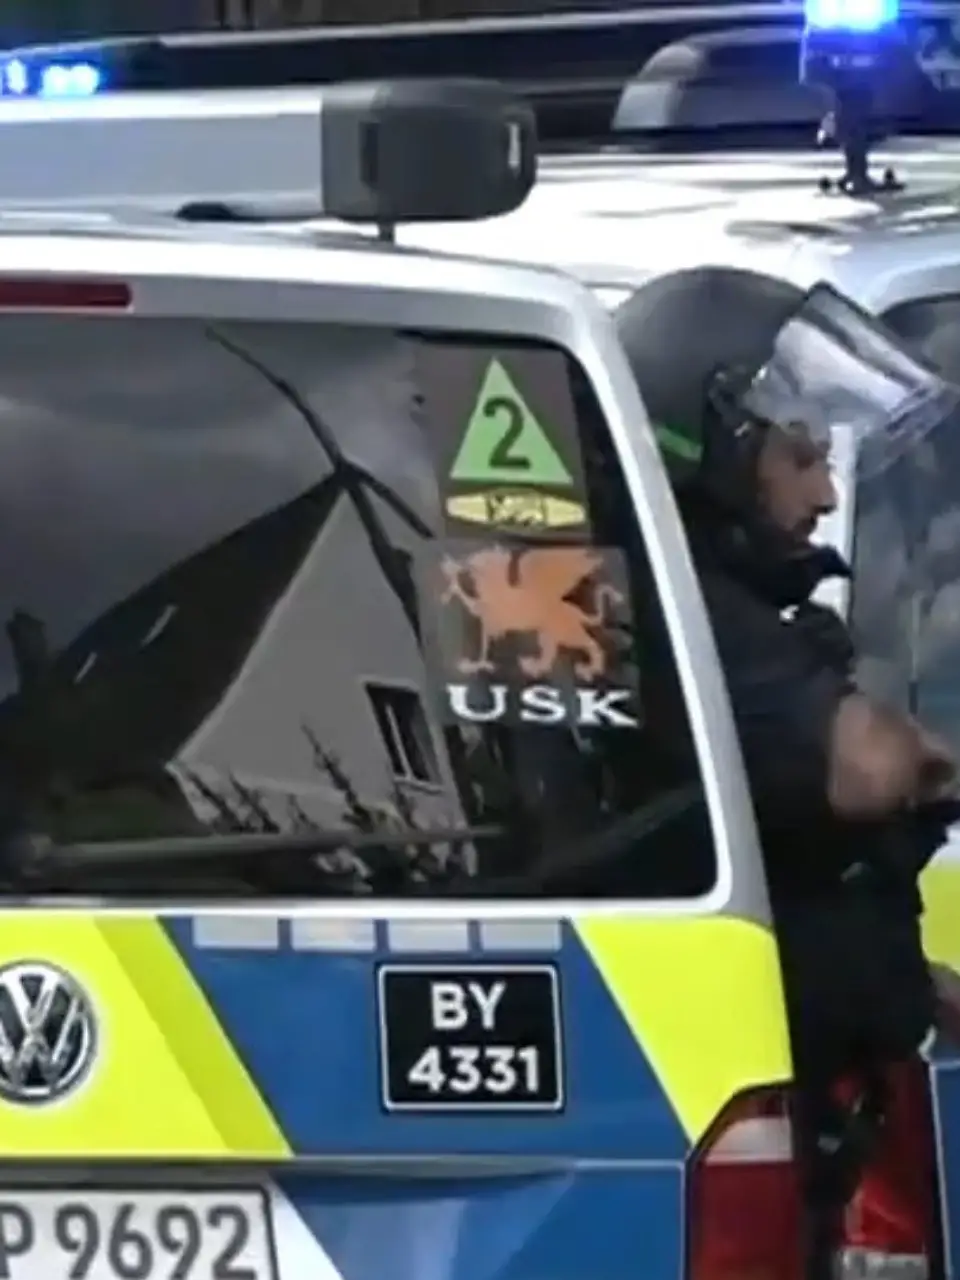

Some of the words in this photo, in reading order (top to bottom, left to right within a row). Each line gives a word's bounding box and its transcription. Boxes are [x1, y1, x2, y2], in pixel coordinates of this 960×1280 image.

[482, 396, 532, 470] 2
[445, 683, 639, 727] USK
[429, 982, 506, 1032] BY
[407, 1046, 539, 1094] 4331
